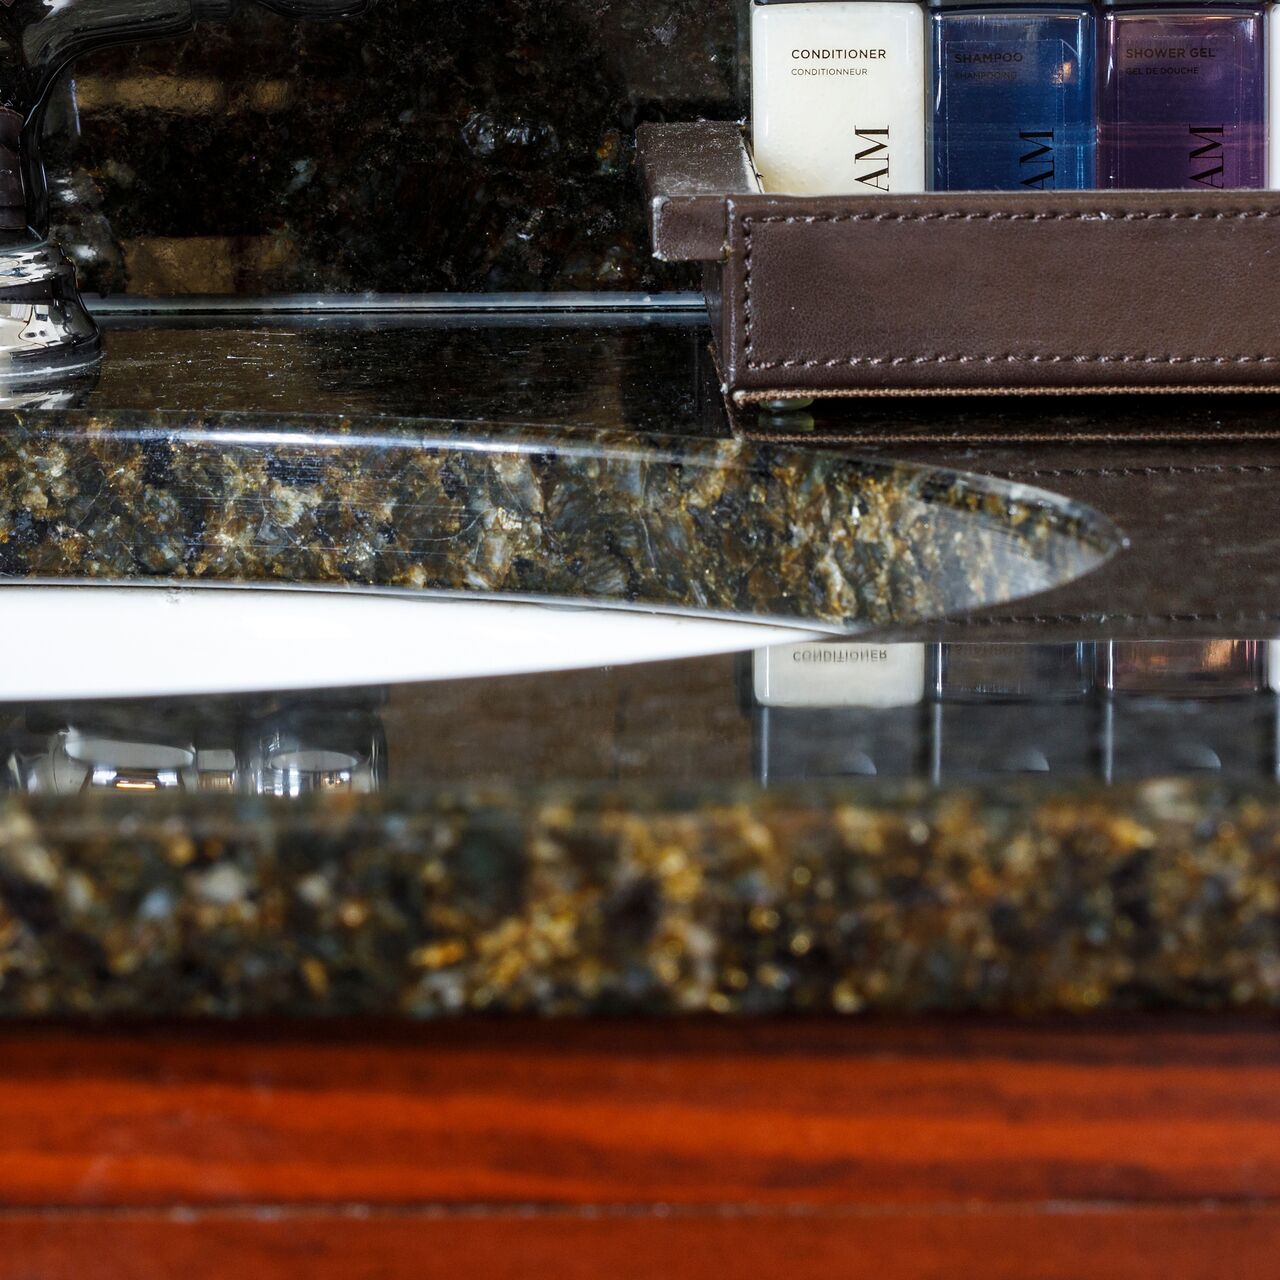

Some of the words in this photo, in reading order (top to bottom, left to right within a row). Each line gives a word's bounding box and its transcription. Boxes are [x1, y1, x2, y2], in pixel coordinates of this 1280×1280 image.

[791, 49, 887, 60] CONDITIONER
[954, 52, 1024, 64] SHAMPOO
[1126, 47, 1186, 59] SHOWER
[1189, 47, 1217, 59] GEL
[791, 68, 868, 76] CONDITIONNEUR
[1125, 67, 1142, 76] GEL
[1145, 67, 1159, 76] DE
[1160, 66, 1200, 76] DOUCHE
